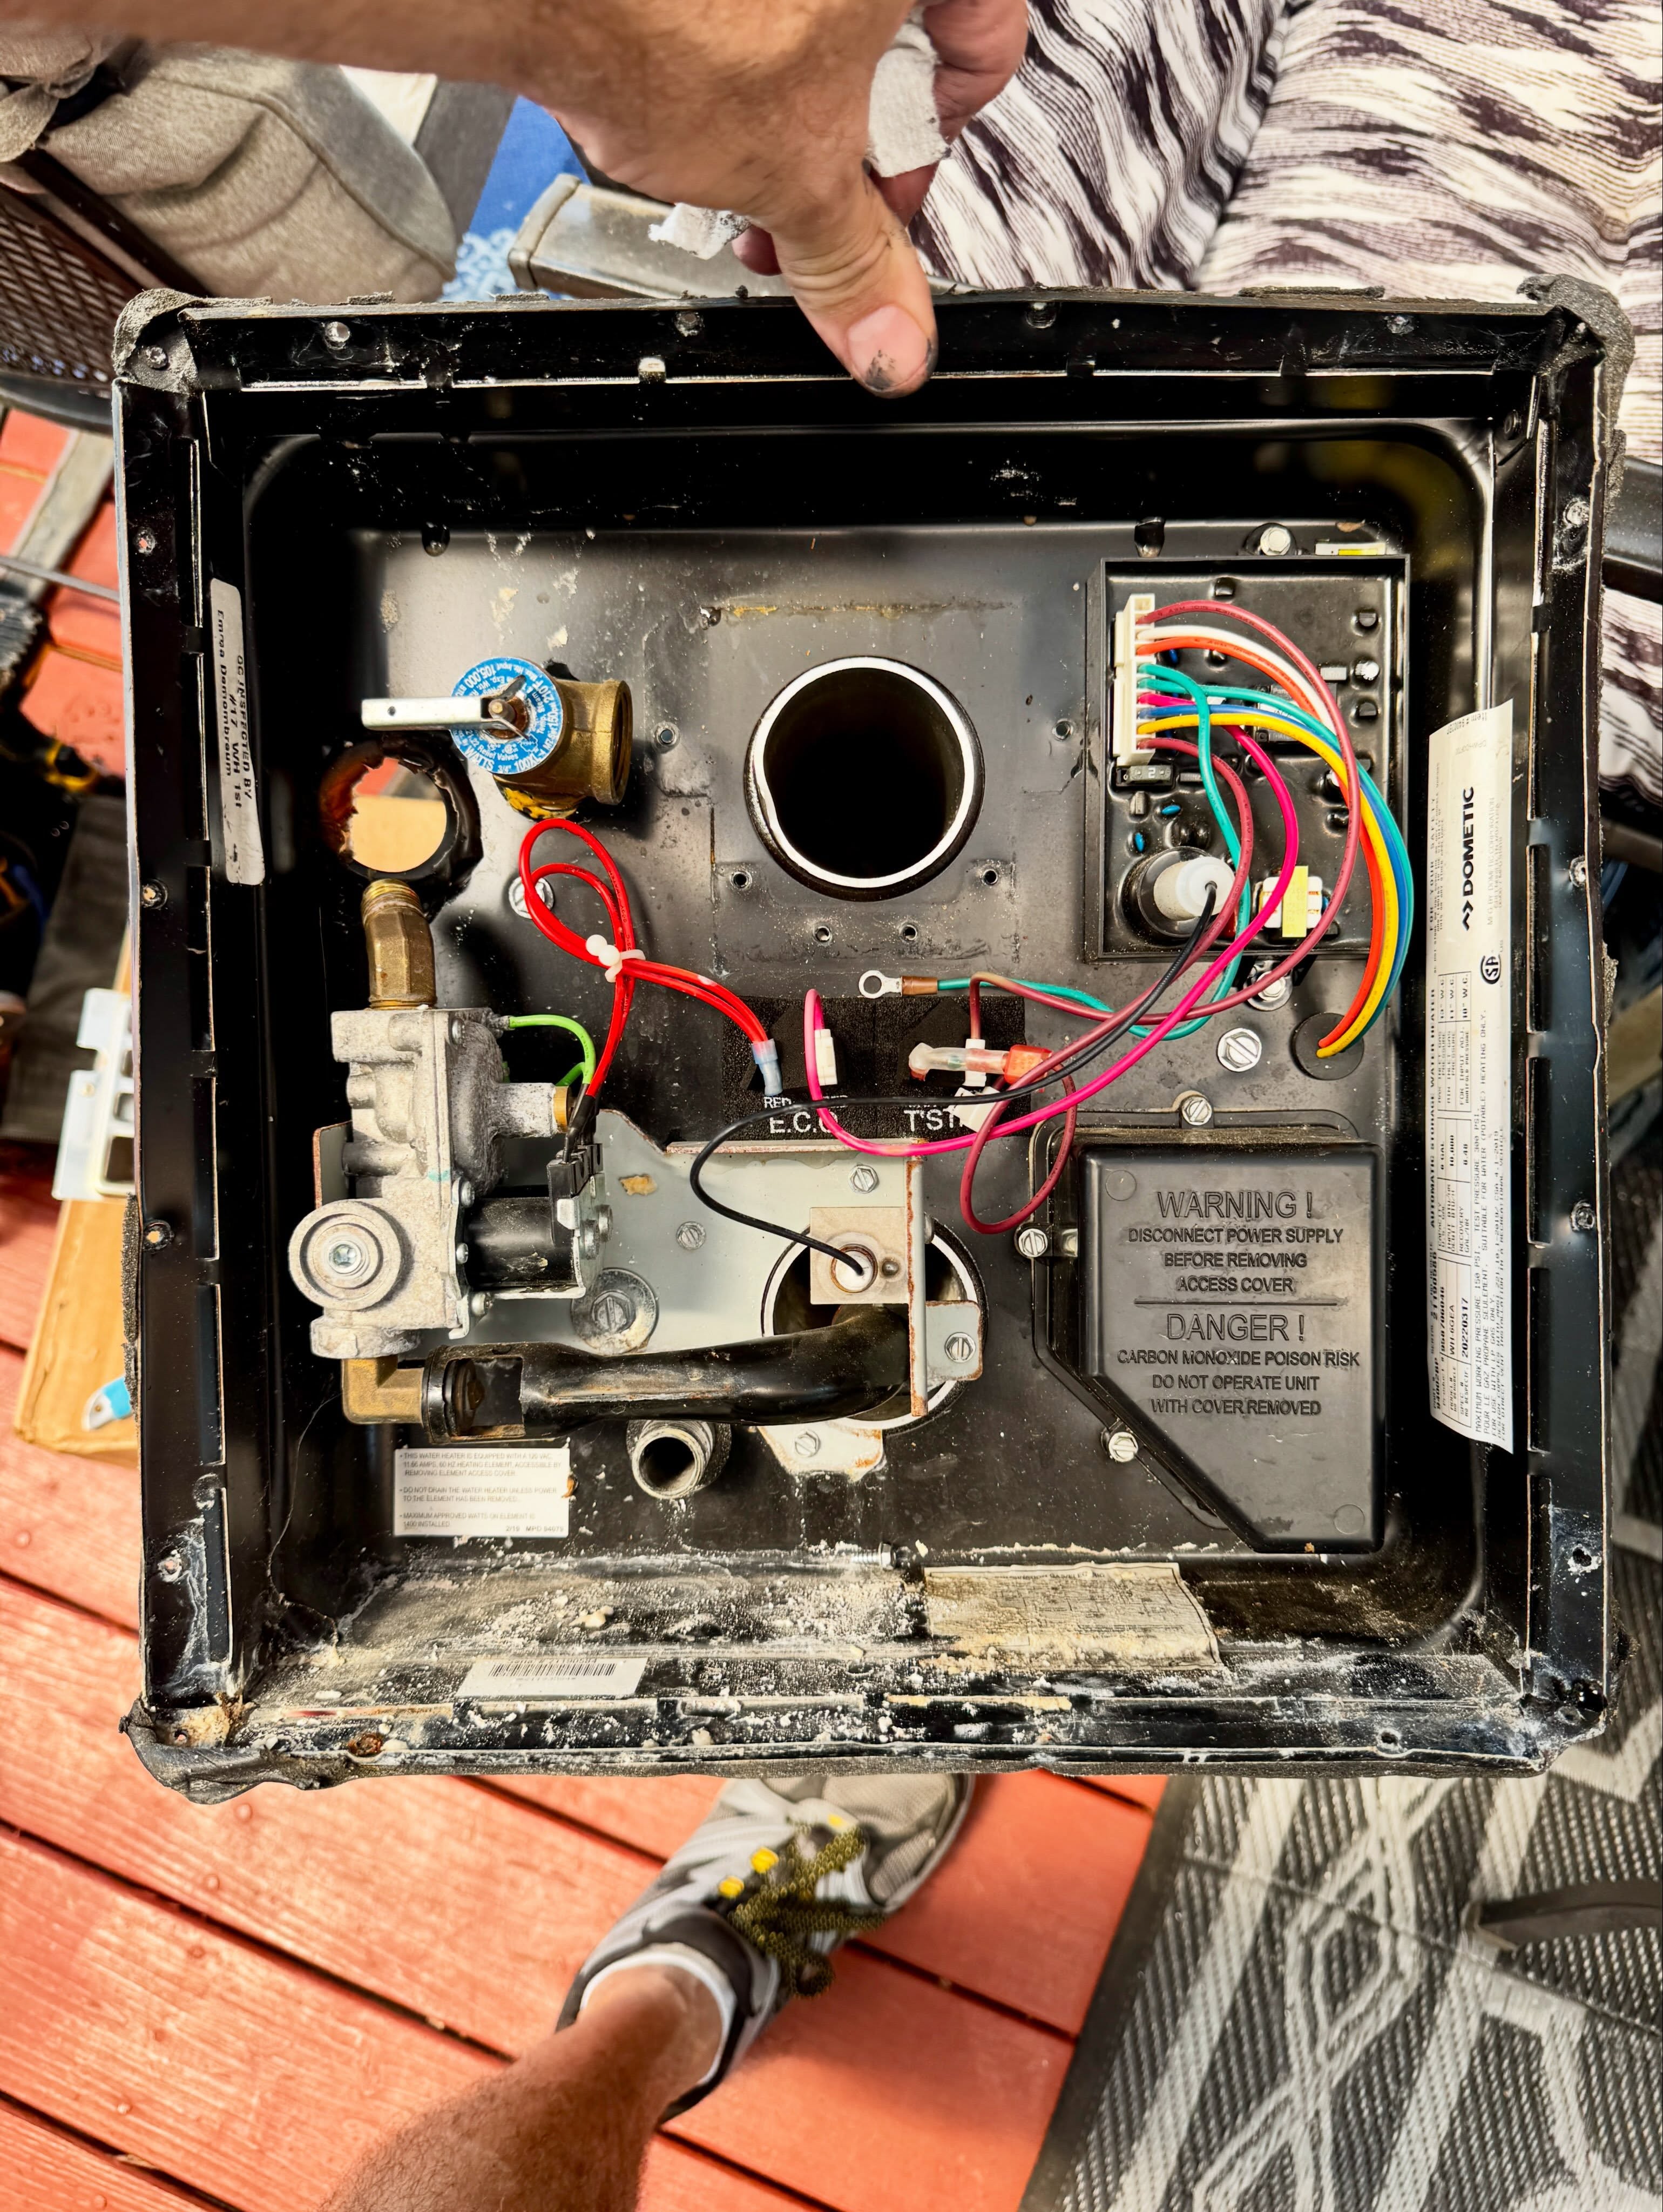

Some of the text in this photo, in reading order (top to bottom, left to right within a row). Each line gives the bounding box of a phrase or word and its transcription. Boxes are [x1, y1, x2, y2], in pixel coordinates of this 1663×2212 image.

[464, 665, 496, 687] 105,000
[229, 694, 238, 728] #17
[232, 742, 240, 773] WH
[464, 746, 494, 771] WATTS
[1148, 767, 1156, 778] 2
[244, 778, 252, 799] BY
[1462, 787, 1474, 896] DOMETIC
[1158, 1191, 1313, 1218] WARNING !
[1128, 1228, 1343, 1243] DISCONNECT POWER SUPPLY
[1164, 1252, 1307, 1267] BEFORE REMOVING
[1179, 1277, 1294, 1292] ACCESS COVER
[1166, 1314, 1305, 1341] DANGER !
[1118, 1350, 1361, 1366] CARBON MONOXIDE POISON RISK
[1491, 1350, 1496, 1361] LP
[1152, 1374, 1320, 1390] DO NOT OPERATE UNIT
[1151, 1399, 1322, 1415] WITH COVER REMOVED
[1483, 1394, 1490, 1406] LE
